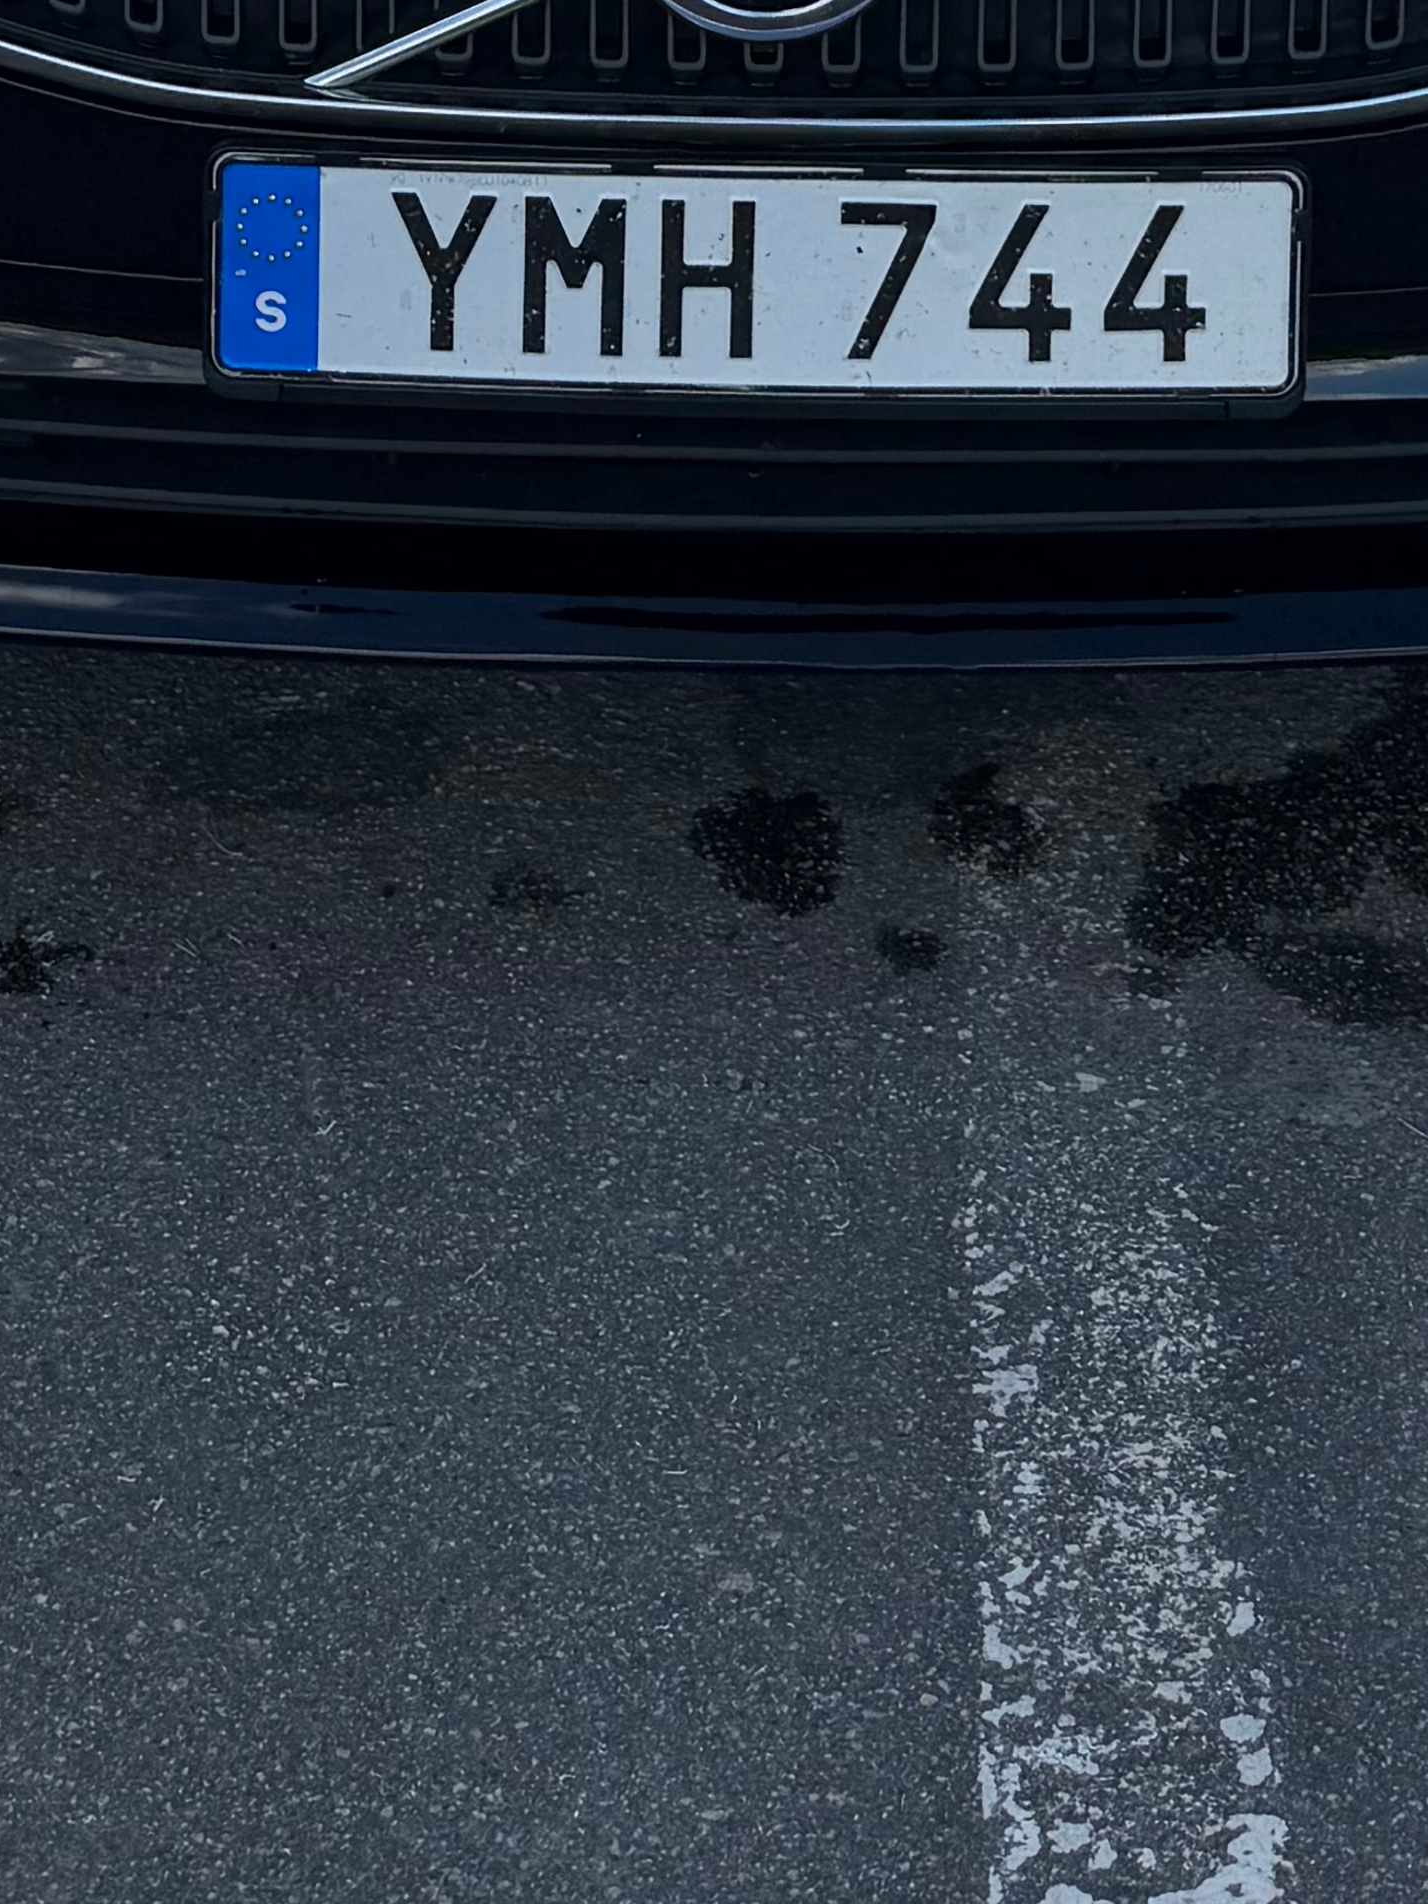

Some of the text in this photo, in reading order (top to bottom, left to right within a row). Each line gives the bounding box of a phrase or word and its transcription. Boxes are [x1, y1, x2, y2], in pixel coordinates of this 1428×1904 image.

[254, 290, 288, 333] S
[391, 191, 1207, 362] YMH 744
